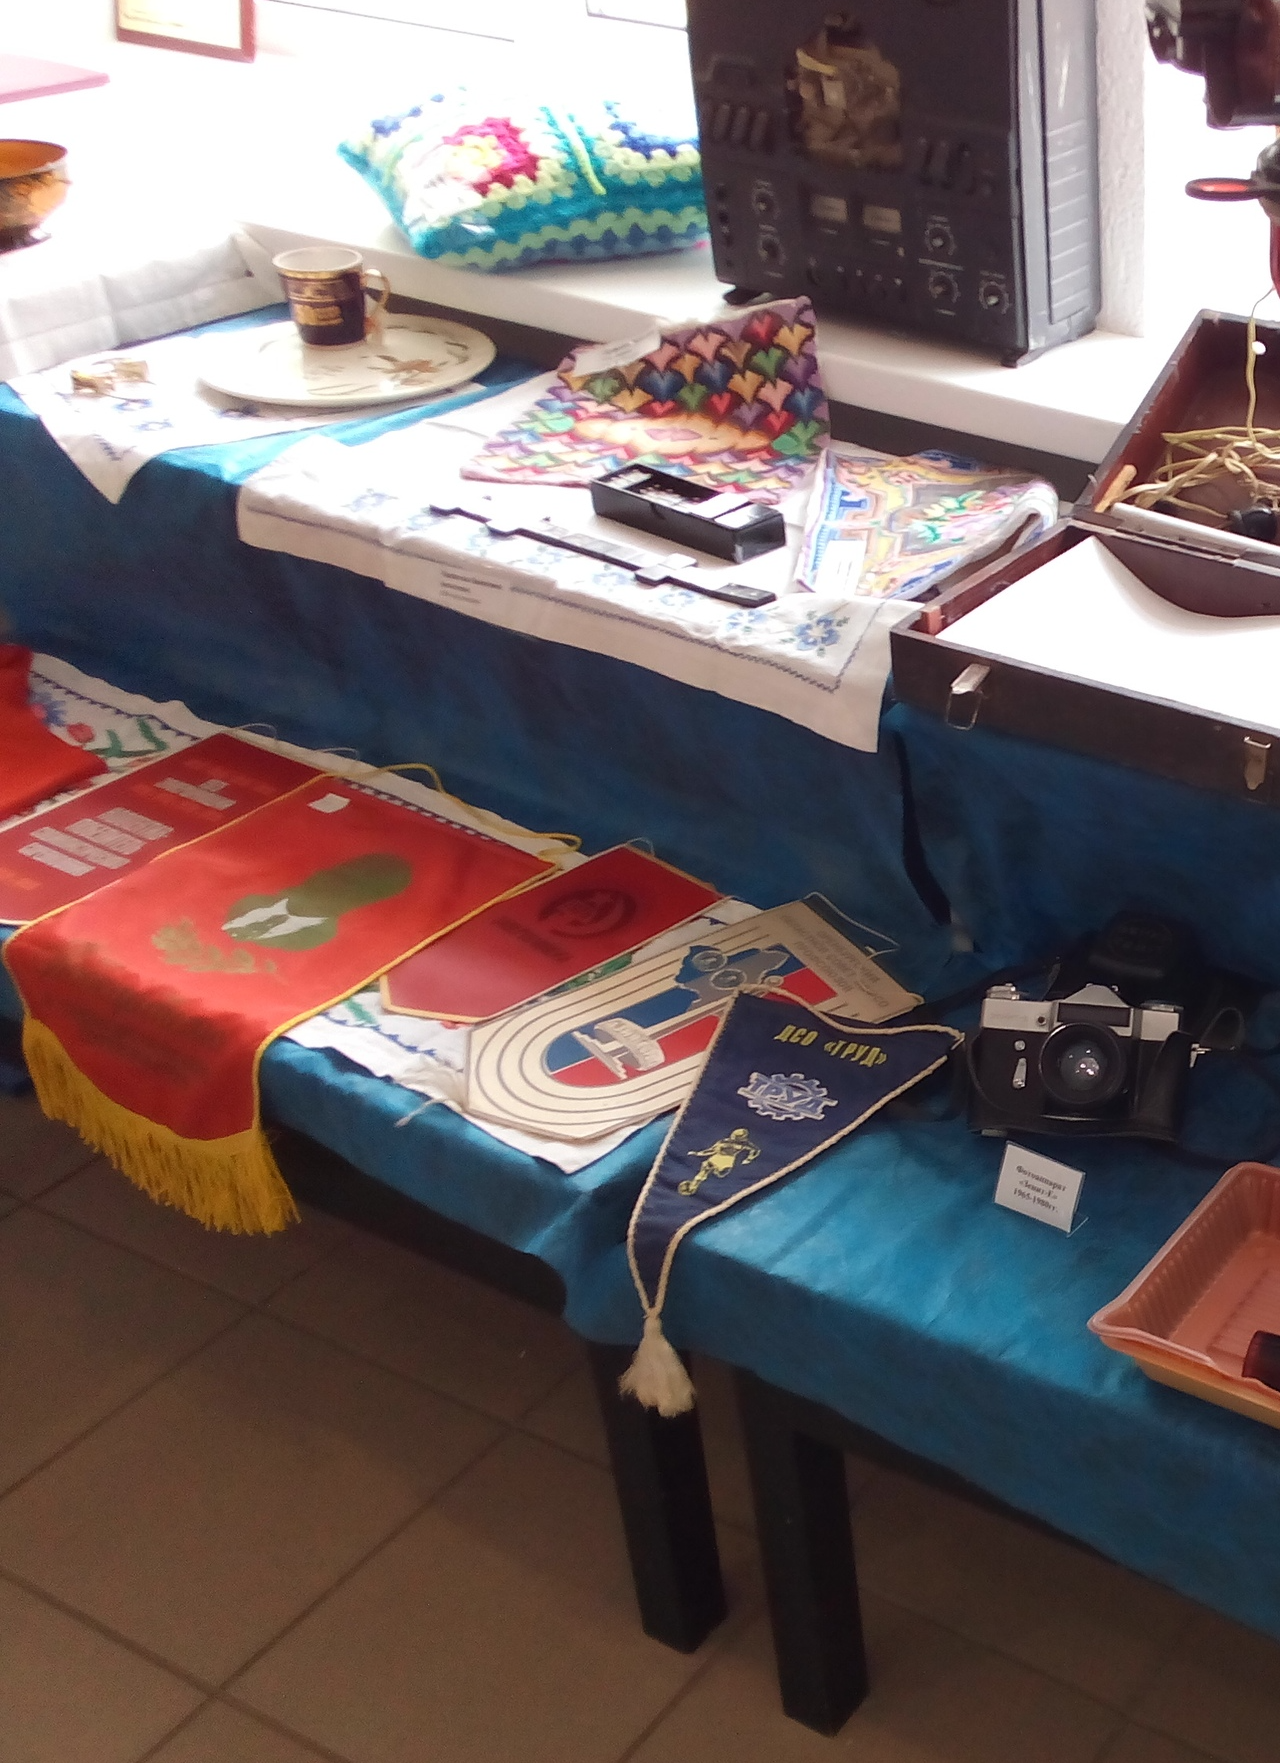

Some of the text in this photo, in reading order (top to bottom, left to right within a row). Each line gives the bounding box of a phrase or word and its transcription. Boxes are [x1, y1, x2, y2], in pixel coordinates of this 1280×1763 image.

[773, 1023, 889, 1068] ДСО «ТРУД»
[737, 1072, 839, 1121] ТРУД
[1015, 1164, 1067, 1192] Фотоаппарат
[1019, 1179, 1058, 1200] «Зенит-Е»
[1013, 1187, 1059, 1213] 1965-1980гг.
